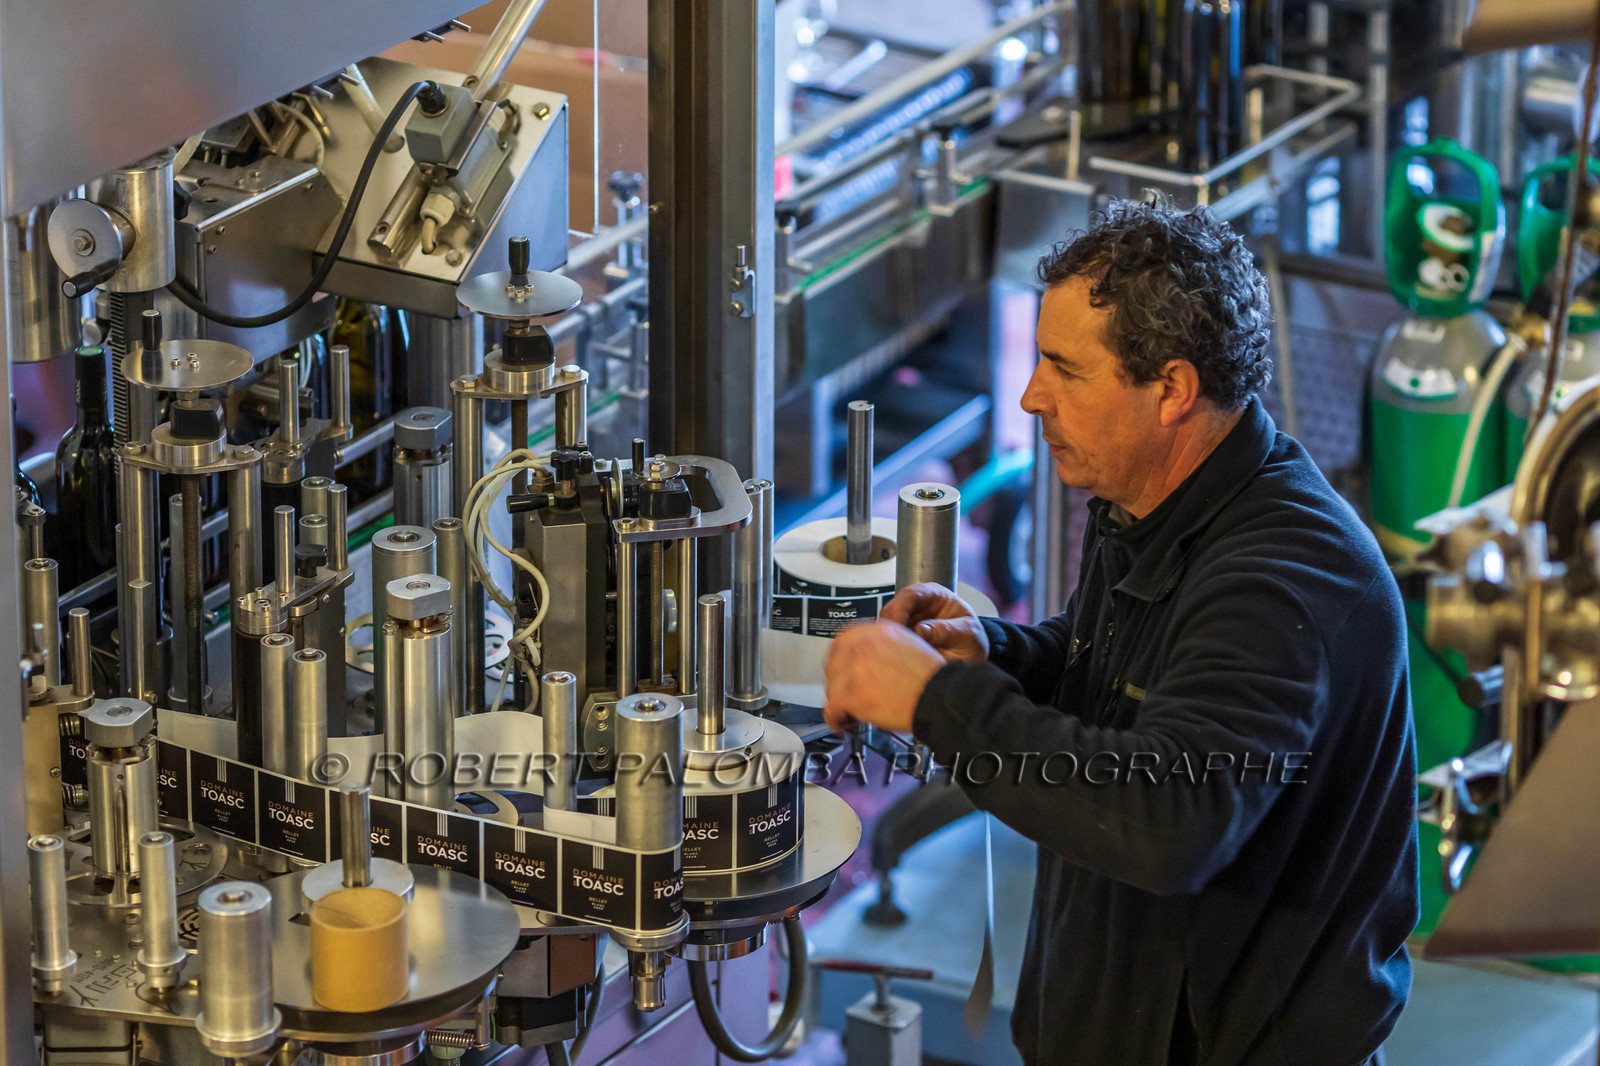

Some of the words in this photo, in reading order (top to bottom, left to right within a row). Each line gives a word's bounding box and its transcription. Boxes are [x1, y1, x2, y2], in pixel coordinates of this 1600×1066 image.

[200, 780, 245, 799] DOMAINE
[200, 786, 245, 810] TOASC
[267, 801, 315, 820] DOMAINE
[268, 807, 315, 830] TOASC
[748, 803, 791, 824] DOMAINE
[748, 810, 791, 835] TOASC
[417, 836, 468, 852] DOMAINE
[417, 842, 468, 863] TOASC
[495, 852, 545, 868] DOMAINE
[495, 858, 546, 879] TOASC
[572, 868, 624, 886] DOMAINE
[573, 875, 624, 896] TOASC
